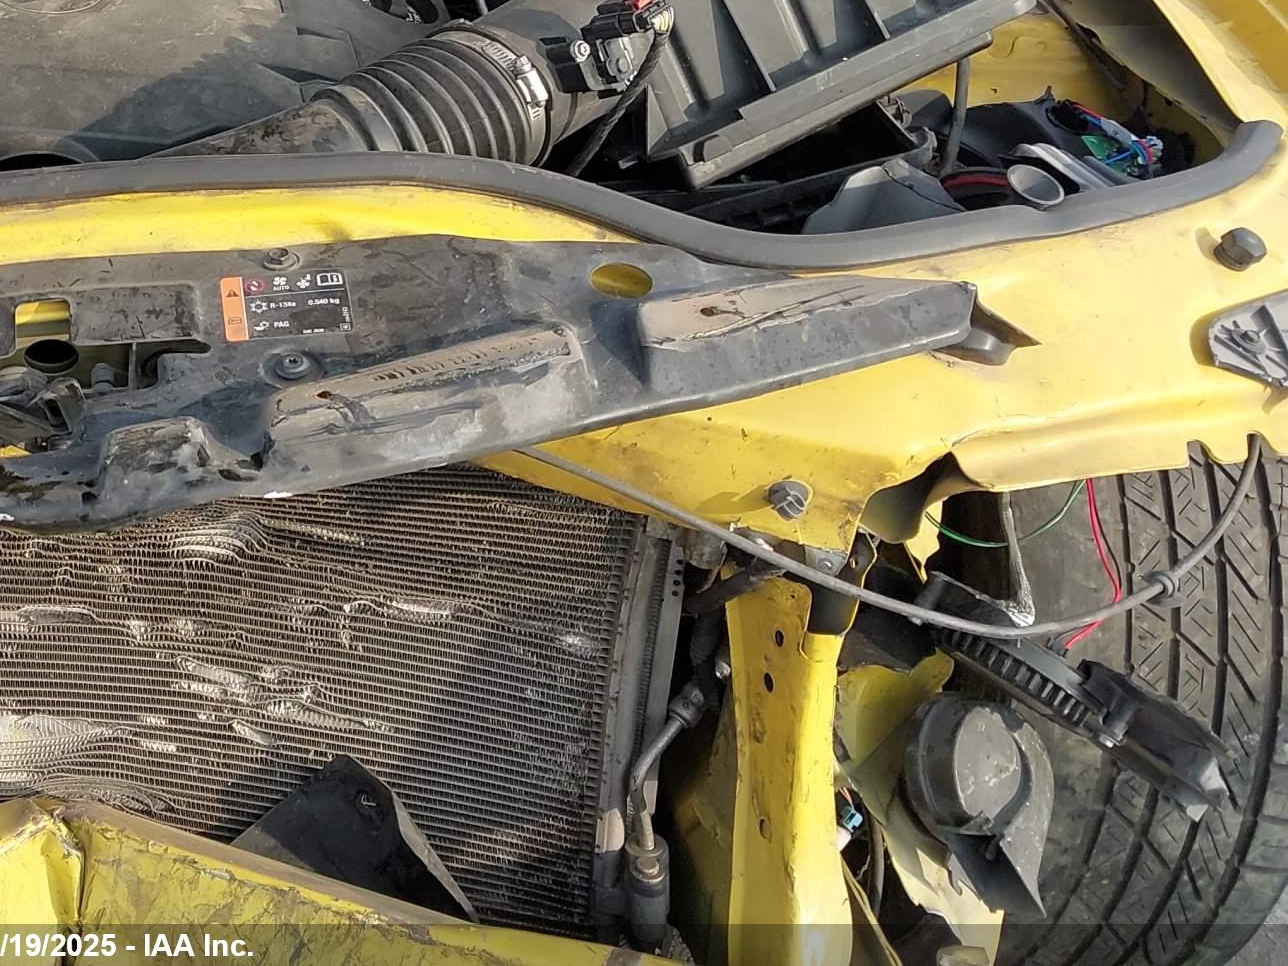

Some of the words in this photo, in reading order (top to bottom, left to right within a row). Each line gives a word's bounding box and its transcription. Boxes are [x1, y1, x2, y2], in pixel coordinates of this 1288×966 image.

[307, 298, 329, 306] 0.540
[329, 297, 340, 305] kg
[273, 320, 290, 329] PAG
